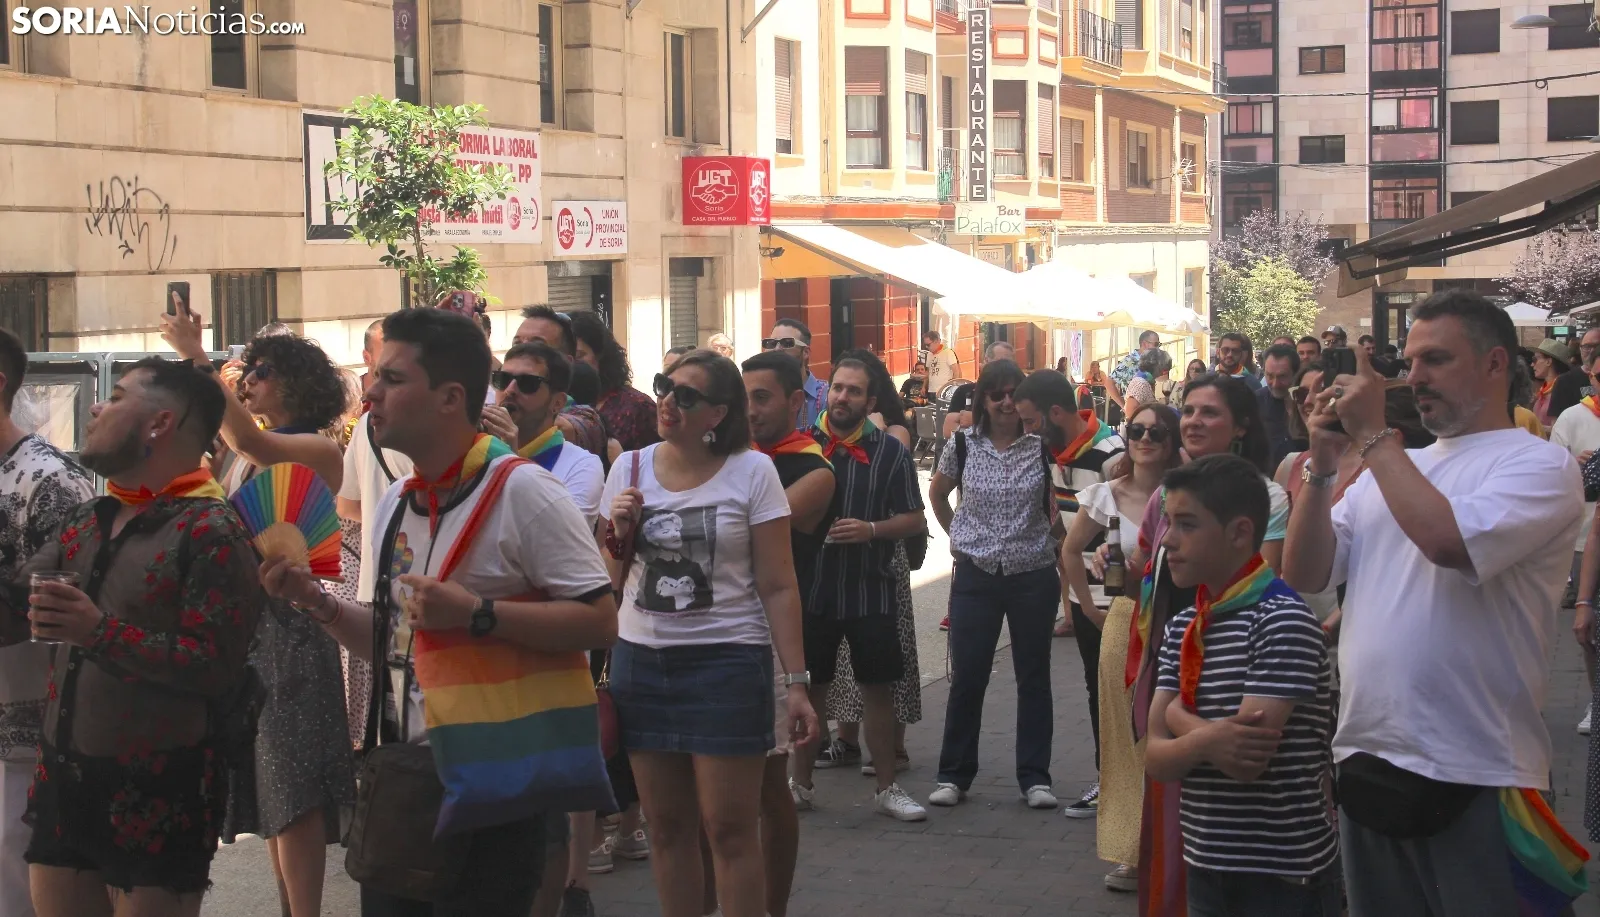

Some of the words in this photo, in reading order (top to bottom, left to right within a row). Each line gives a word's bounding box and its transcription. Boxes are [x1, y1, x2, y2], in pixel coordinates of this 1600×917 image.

[970, 14, 986, 199] RESTAURANTE
[493, 136, 537, 159] LABORAL
[518, 163, 532, 183] PP
[698, 170, 731, 187] UGT
[752, 170, 766, 188] UGT
[997, 205, 1021, 216] Bar
[596, 223, 626, 233] PROVINCIAL
[957, 216, 1021, 234] Palafox
[600, 237, 607, 247] DE
[608, 237, 623, 247] SORIA
